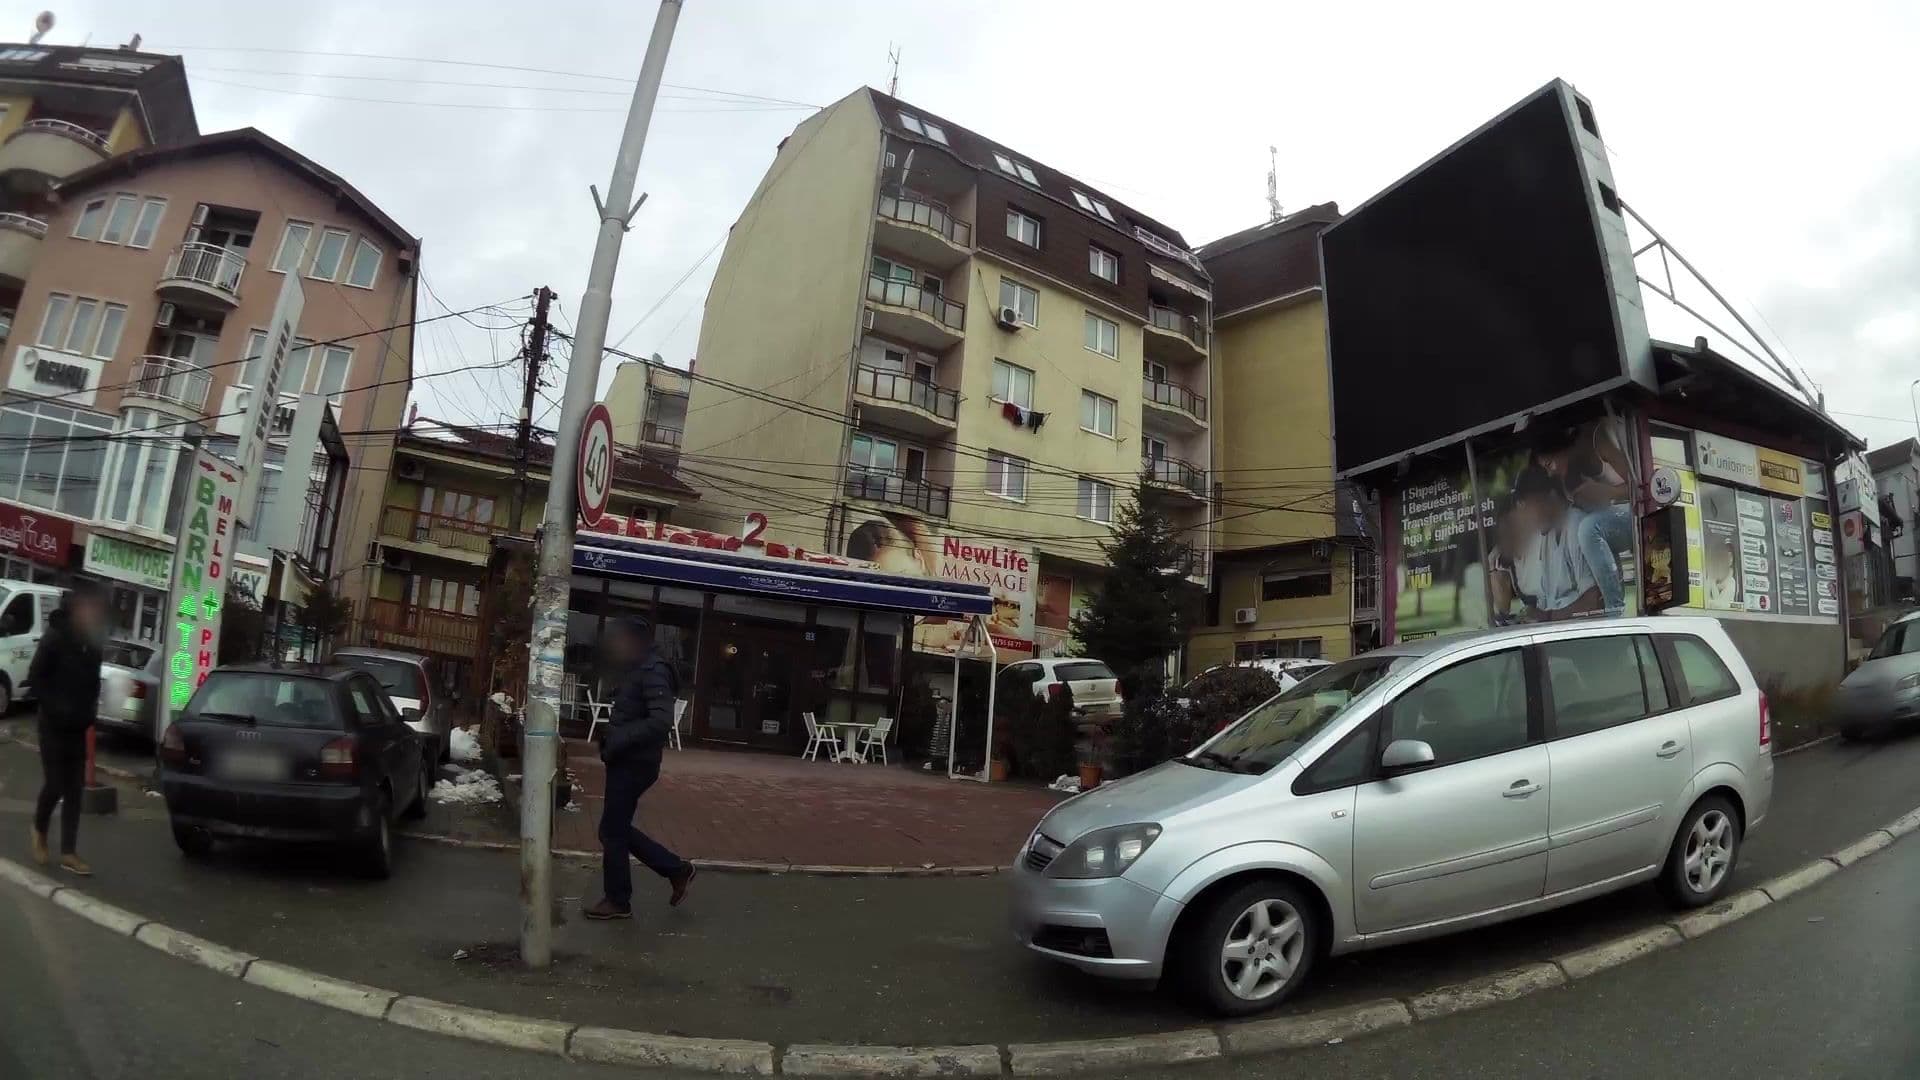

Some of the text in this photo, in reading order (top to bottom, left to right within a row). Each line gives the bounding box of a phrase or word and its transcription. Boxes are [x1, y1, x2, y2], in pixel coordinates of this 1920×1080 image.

[585, 435, 608, 497] 40
[1456, 497, 1495, 519] parsh
[743, 512, 769, 547] 2
[1403, 532, 1423, 547] nga
[943, 535, 1029, 573] NewLife
[942, 562, 1028, 593] MASSAGE
